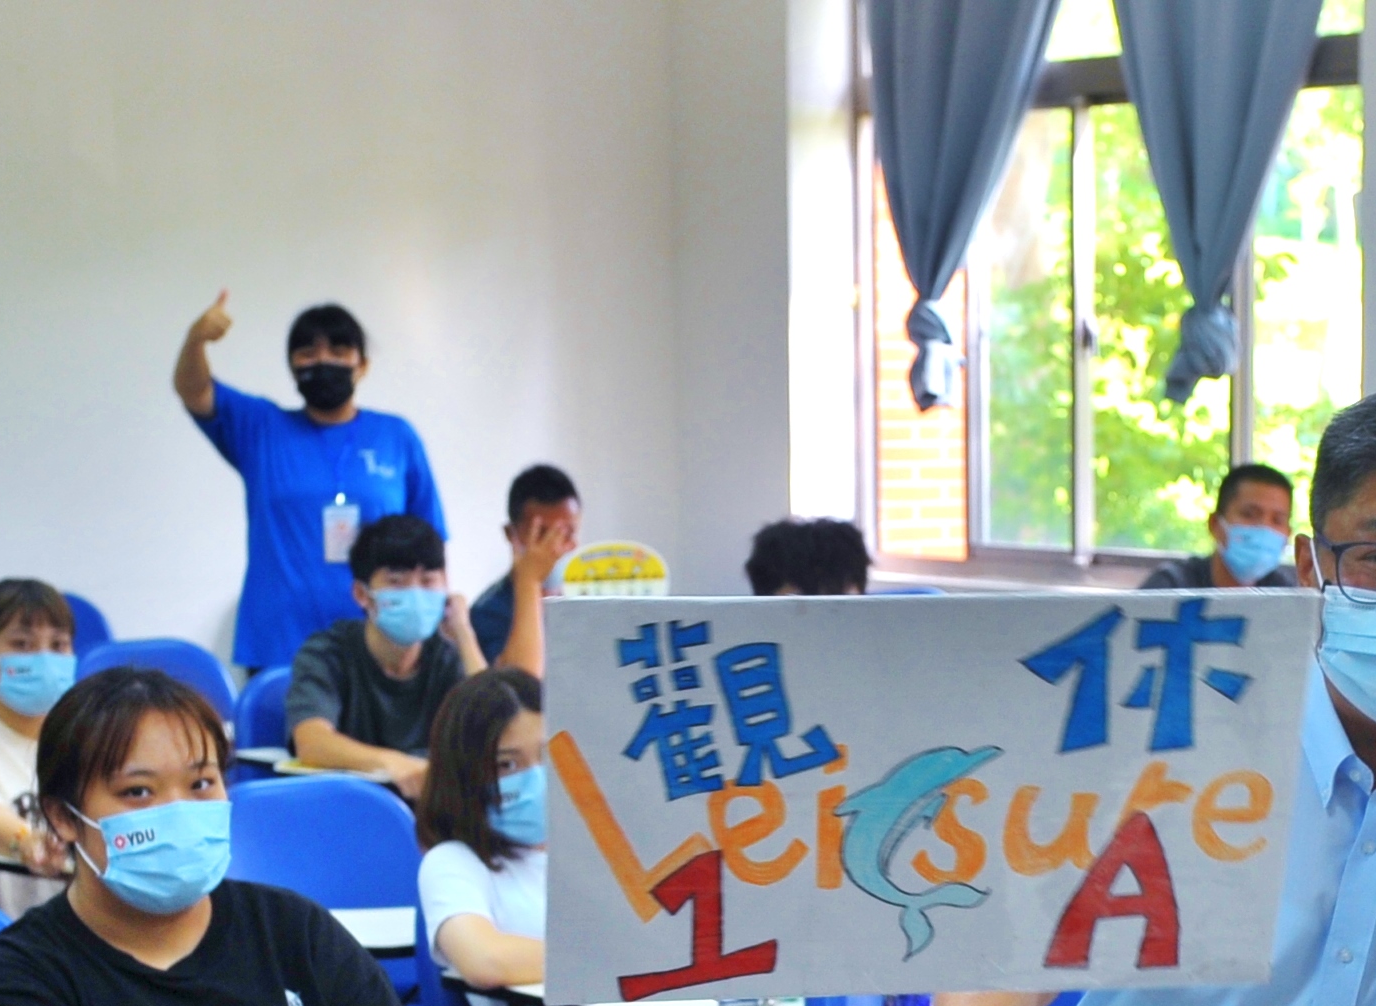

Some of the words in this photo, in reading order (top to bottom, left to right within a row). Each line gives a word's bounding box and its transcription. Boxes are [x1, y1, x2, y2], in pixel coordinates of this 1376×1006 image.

[616, 620, 842, 801] 觀
[1018, 598, 1253, 754] 休
[126, 828, 155, 846] YDU
[548, 730, 1274, 921] Leisure
[618, 850, 777, 1000] 1
[1043, 811, 1180, 968] A
